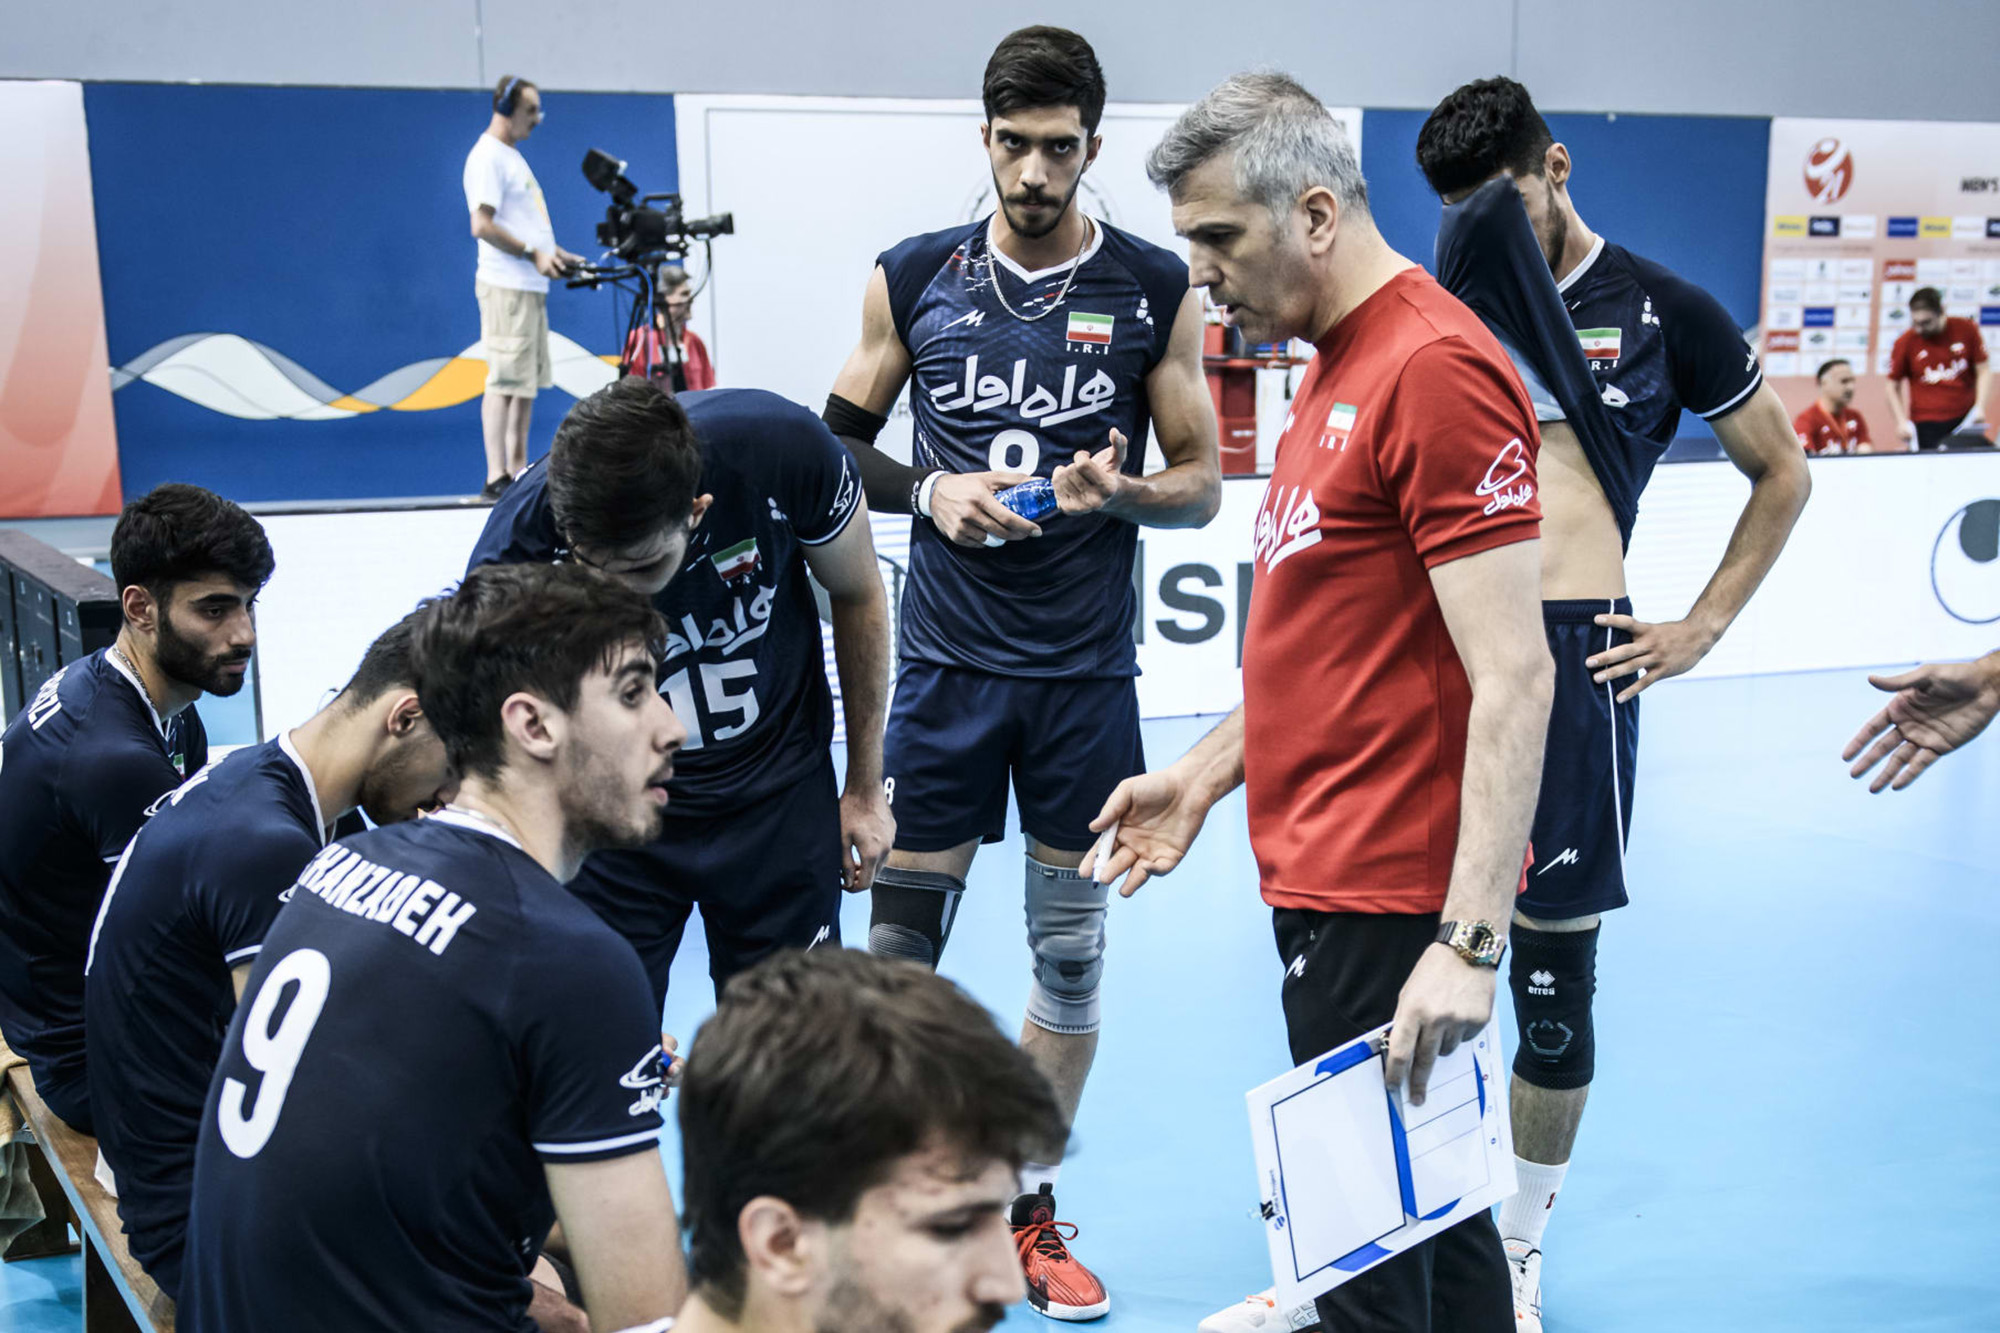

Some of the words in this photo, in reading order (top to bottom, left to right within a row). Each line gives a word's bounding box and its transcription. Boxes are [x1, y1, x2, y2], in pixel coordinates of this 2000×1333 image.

[1066, 342, 1109, 355] I.R.I
[658, 658, 760, 750] 15
[298, 842, 477, 956] HANZADEH
[218, 948, 331, 1159] 9
